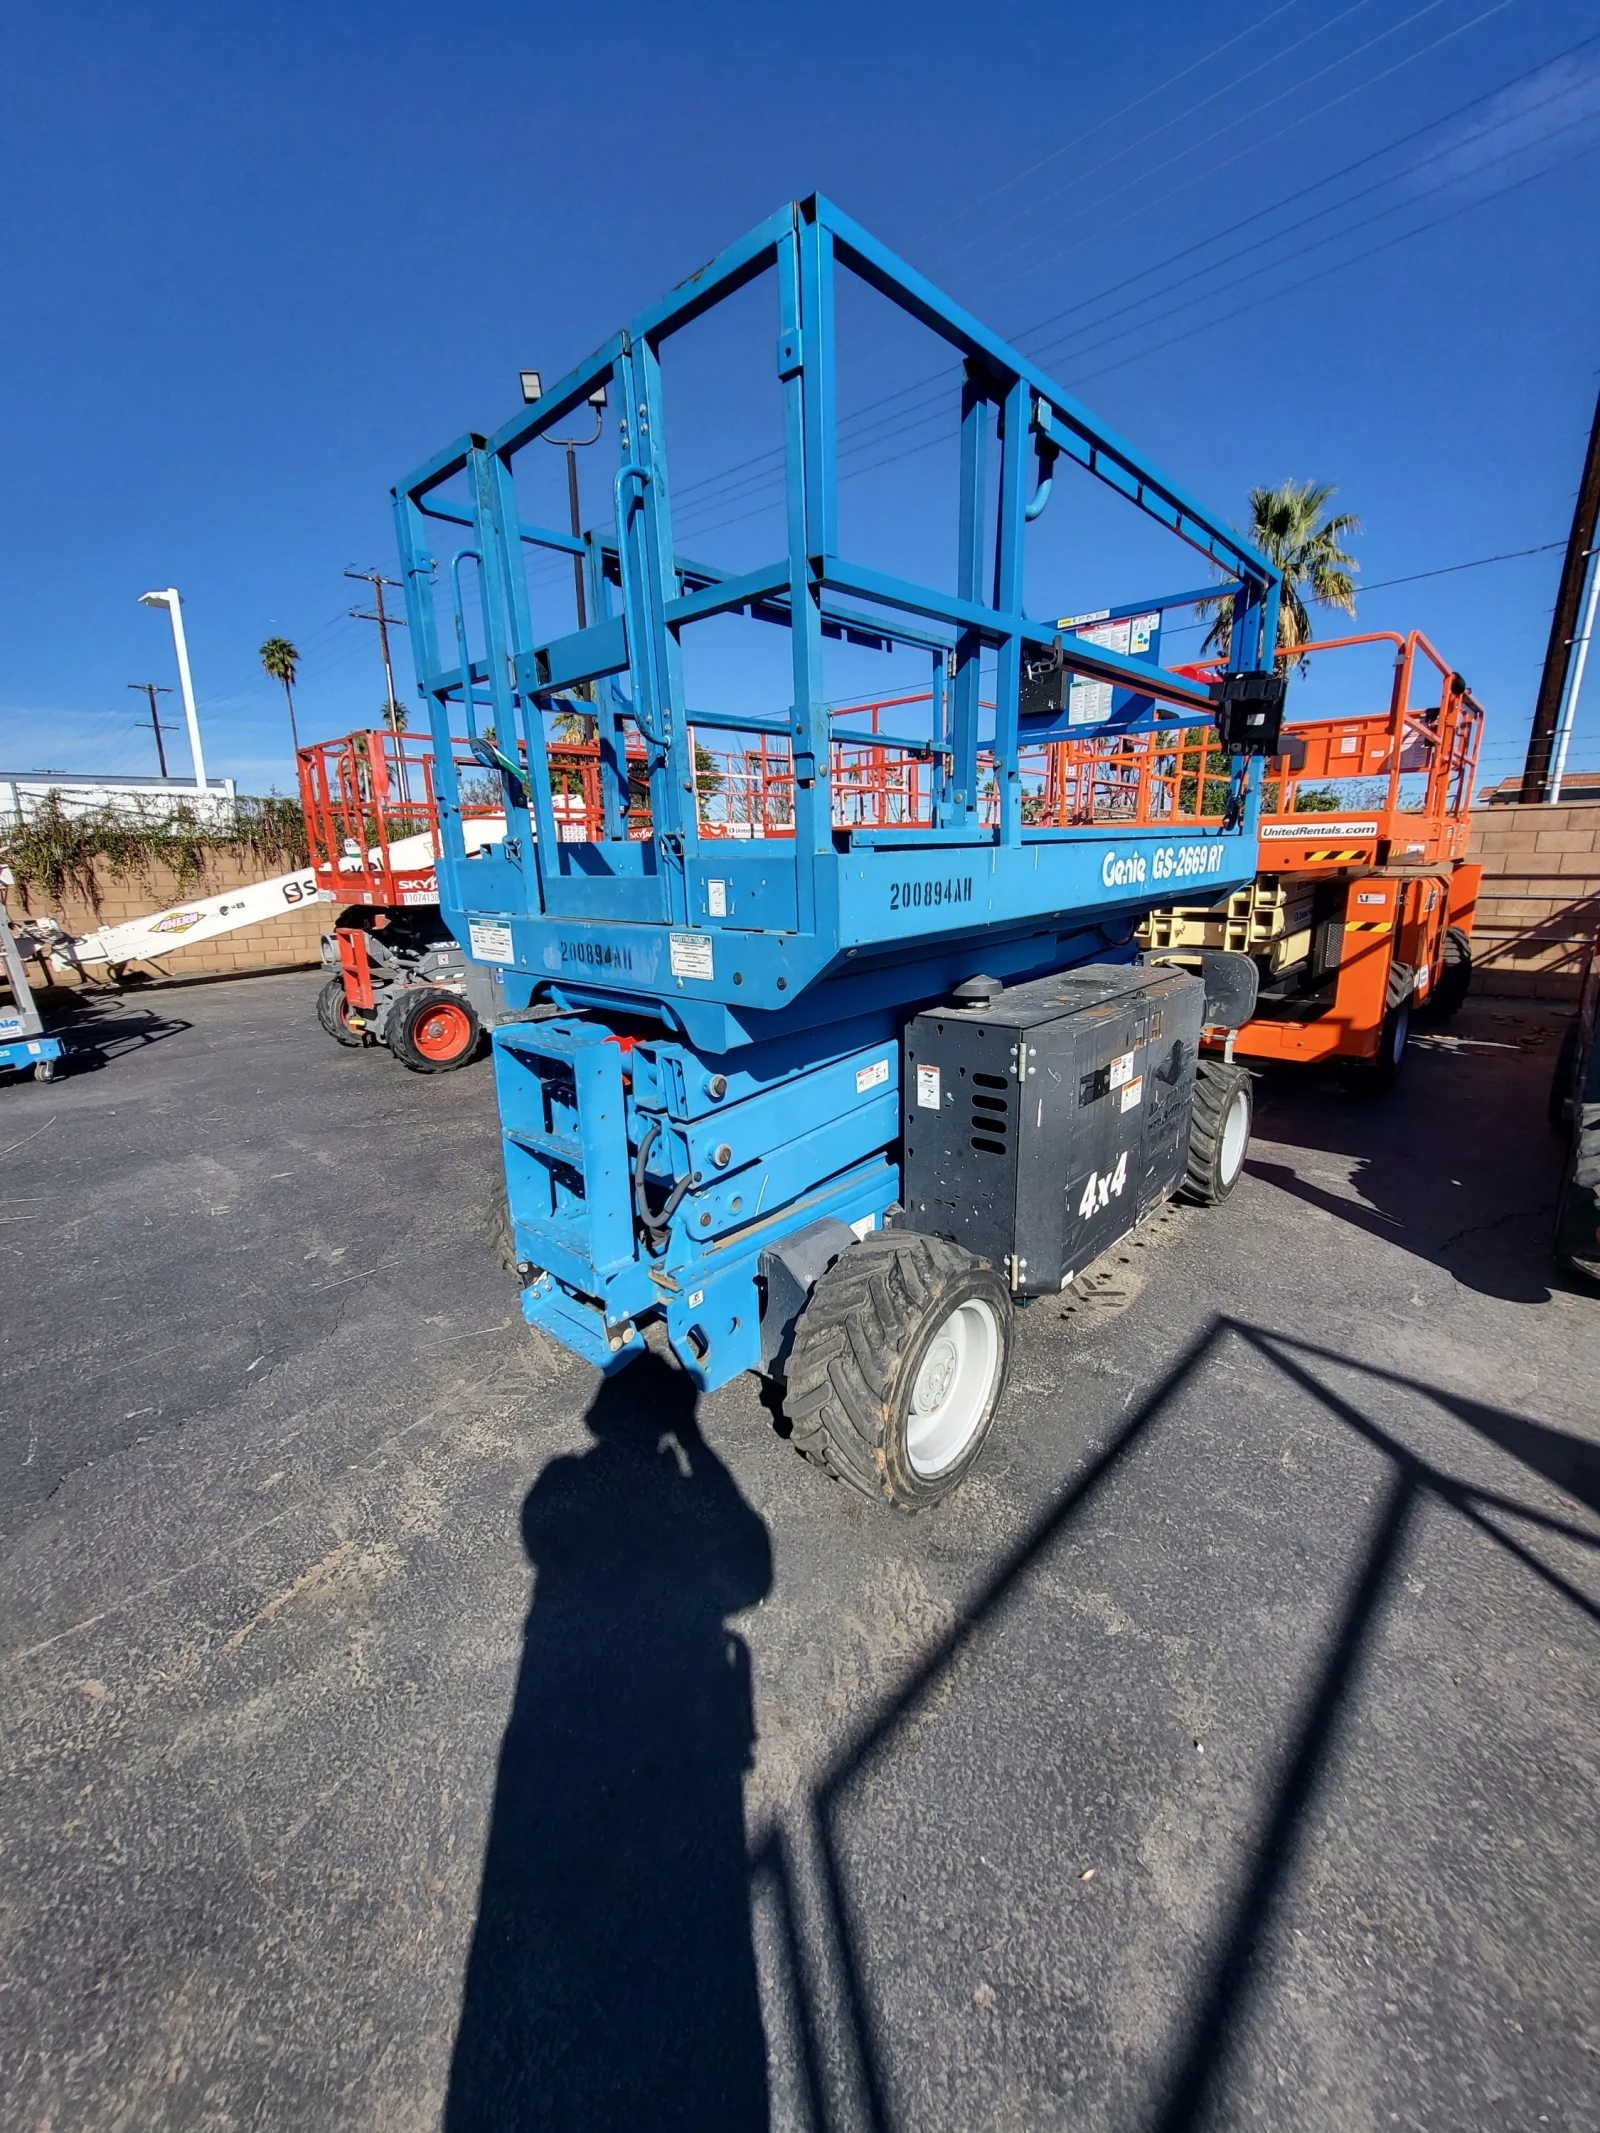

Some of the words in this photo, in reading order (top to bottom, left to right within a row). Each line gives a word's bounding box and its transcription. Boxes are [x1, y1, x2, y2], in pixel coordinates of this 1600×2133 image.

[1262, 826, 1376, 837] UnitedRentals.com
[1102, 851, 1147, 887] Genie
[1152, 844, 1208, 880] GS-2669
[1207, 844, 1224, 873] RT
[398, 875, 438, 891] SKYJ
[890, 877, 972, 910] 200894AH
[1079, 1150, 1128, 1220] 4x4
